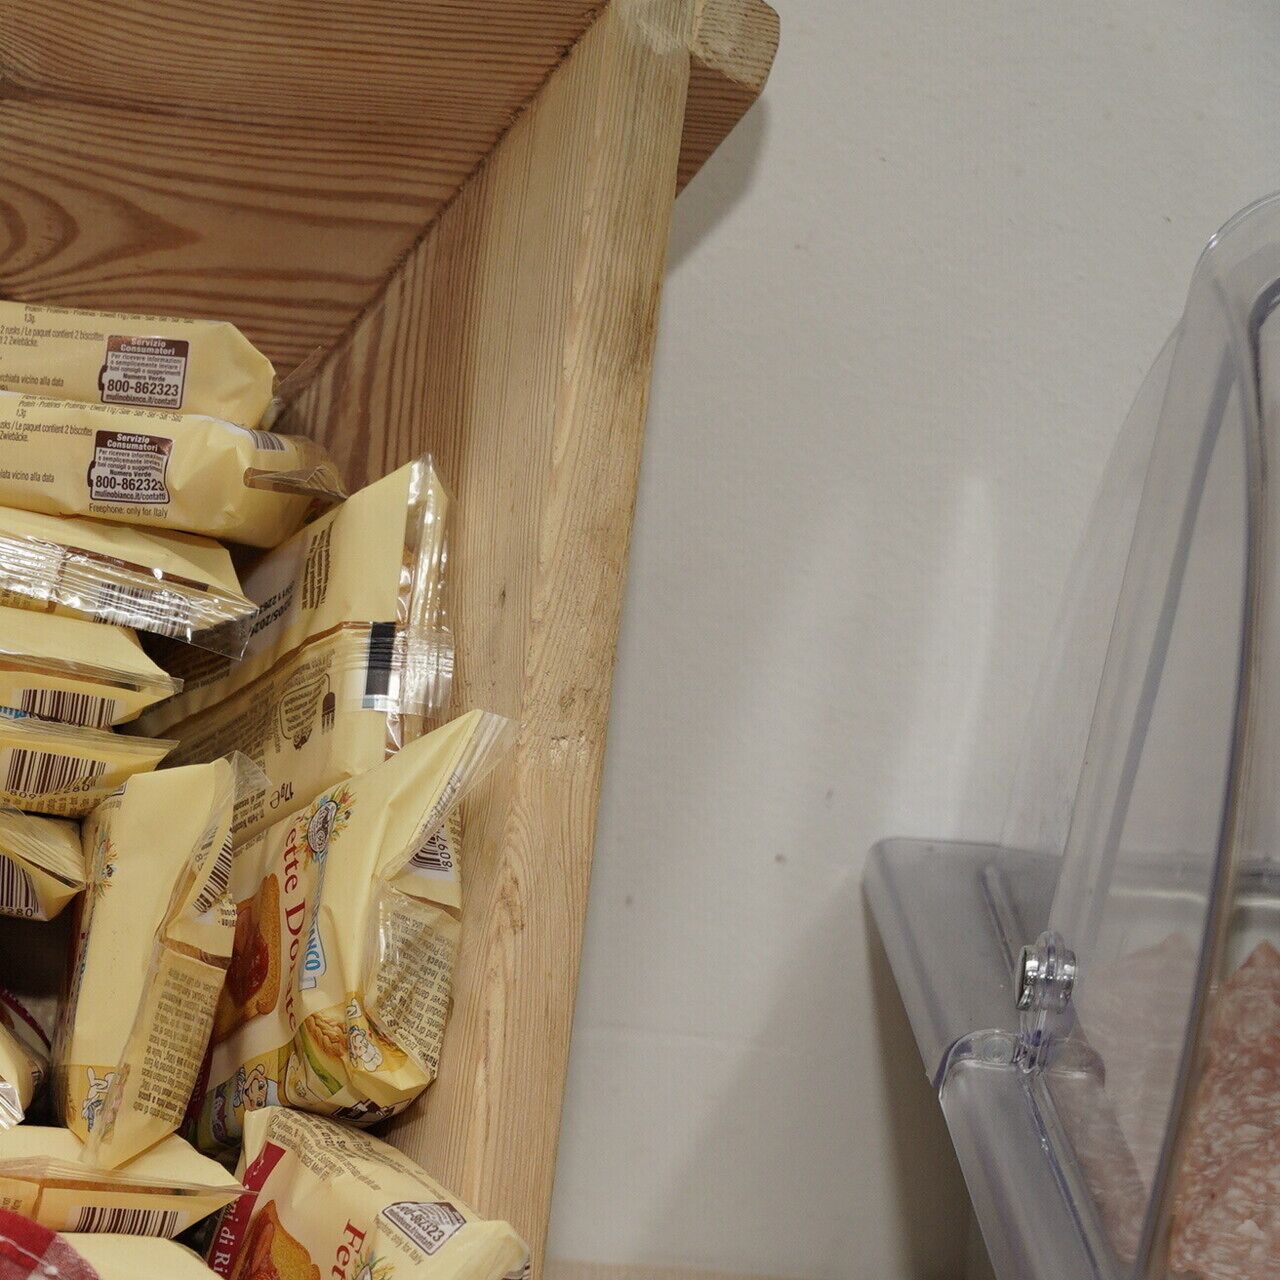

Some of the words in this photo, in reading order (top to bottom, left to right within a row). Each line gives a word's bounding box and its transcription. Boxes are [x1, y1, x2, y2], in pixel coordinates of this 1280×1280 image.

[131, 338, 166, 347] Servizio
[120, 344, 175, 355] Consumatori
[107, 380, 179, 396] 800-862323
[117, 434, 150, 443] Servizio
[107, 440, 158, 451] Consumatori
[95, 476, 164, 491] 800-862323
[89, 503, 124, 514] Freephone:
[126, 507, 140, 515] only
[143, 507, 151, 515] for
[153, 508, 168, 518] Italy
[218, 1226, 235, 1246] di
